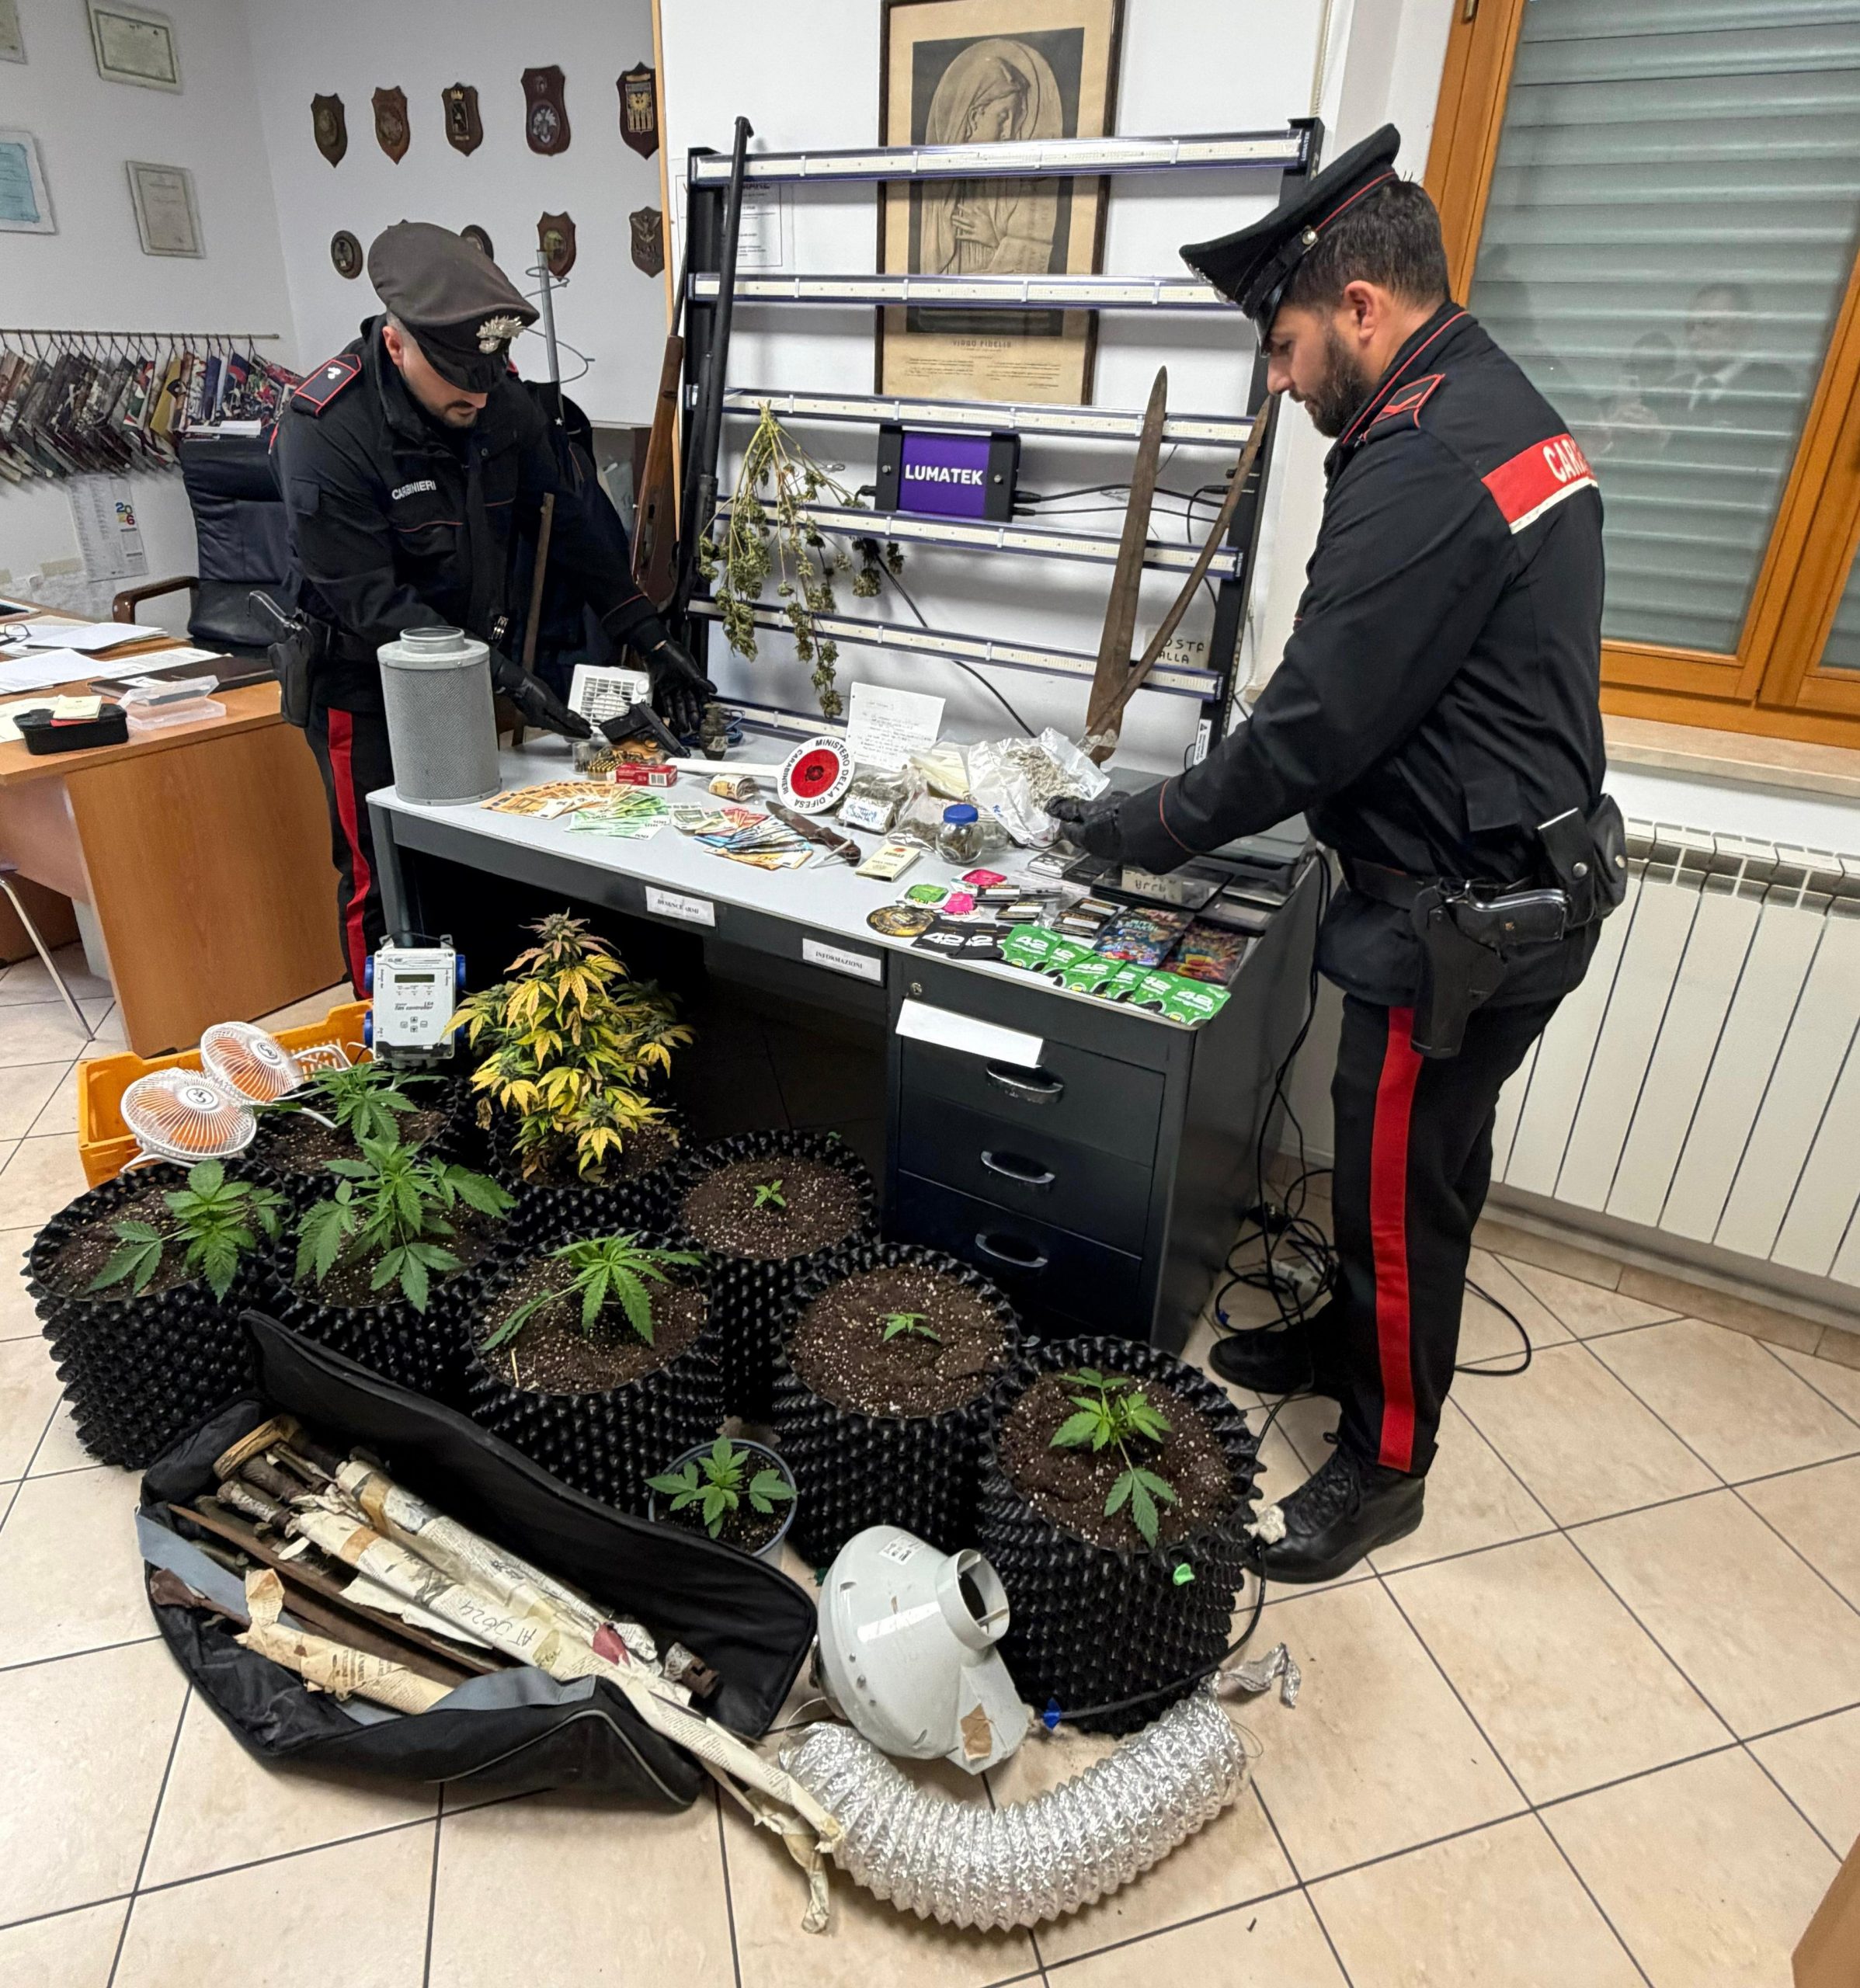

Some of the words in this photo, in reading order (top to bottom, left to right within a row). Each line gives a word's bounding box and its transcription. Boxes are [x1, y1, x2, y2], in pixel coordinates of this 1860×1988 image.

[905, 464, 983, 485] LUMATEK
[1158, 651, 1190, 664] ALLA
[815, 739, 850, 766] MINISTERO
[827, 769, 849, 798] DELLA
[794, 797, 826, 808] DIFESA
[922, 932, 965, 946] 42
[965, 935, 993, 946] 2
[1015, 936, 1048, 951] 42
[815, 951, 863, 969] INFORMAZIONI
